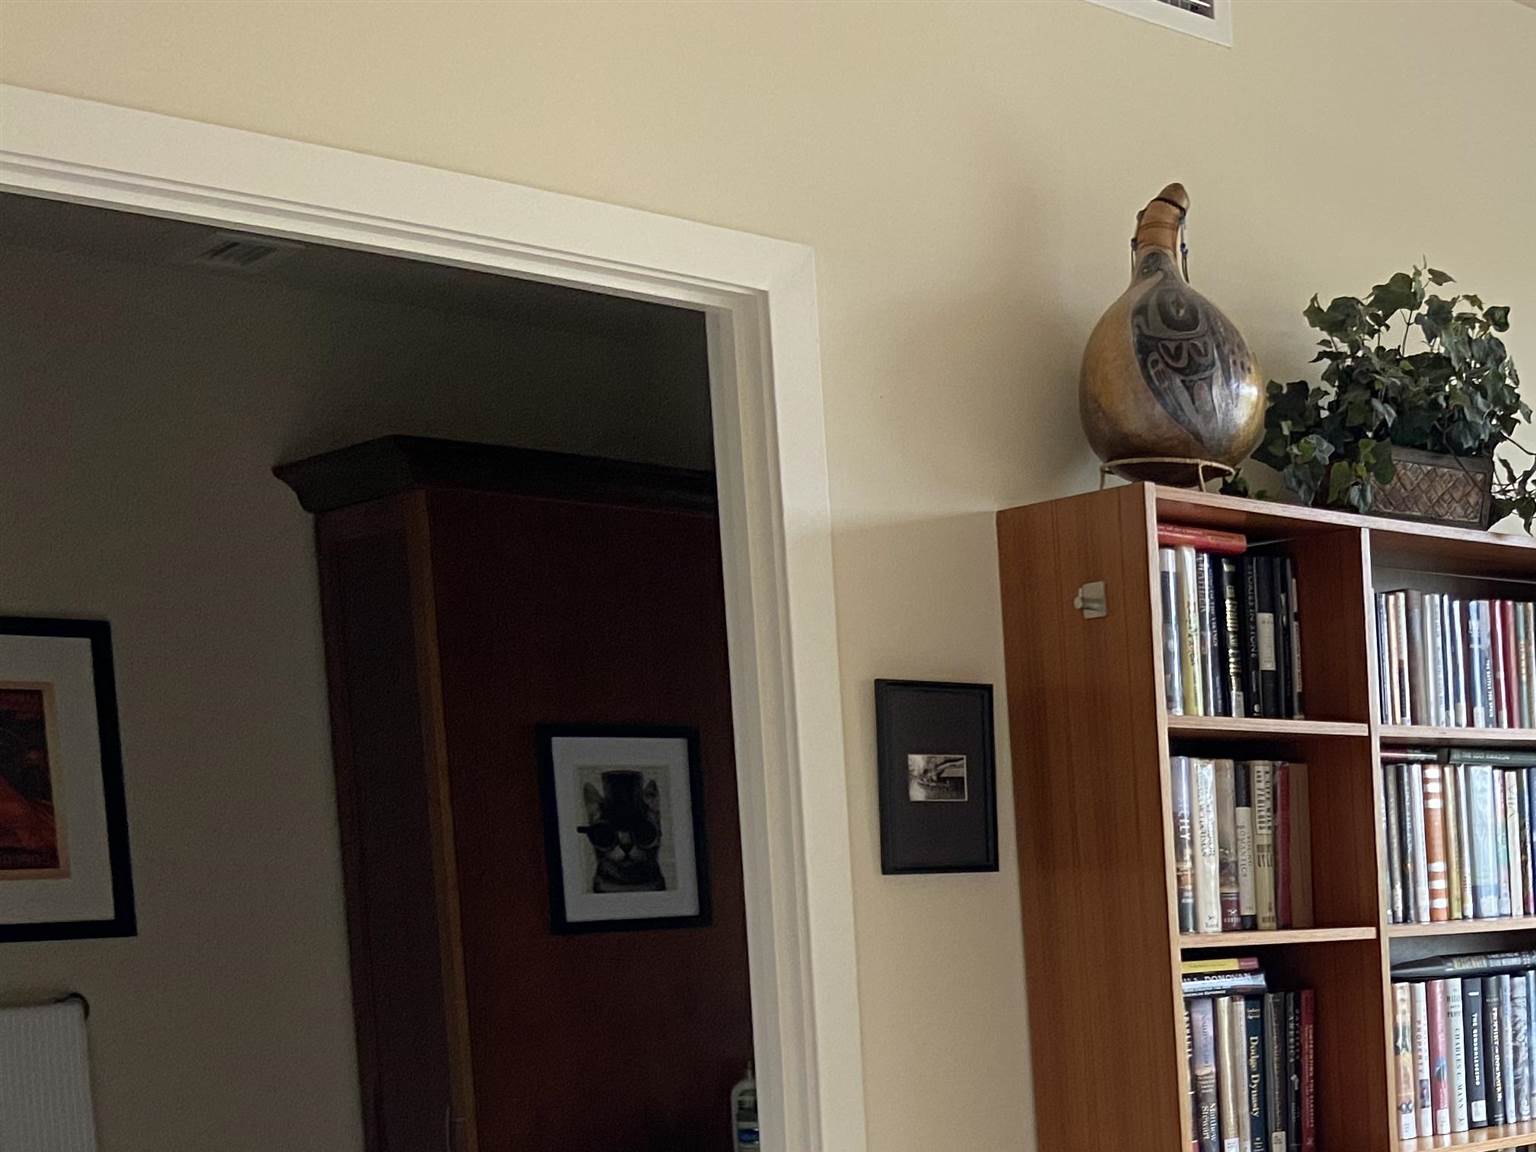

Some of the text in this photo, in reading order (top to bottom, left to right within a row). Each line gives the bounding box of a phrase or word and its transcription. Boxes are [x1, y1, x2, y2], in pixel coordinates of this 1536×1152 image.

[1287, 1014, 1296, 1062] AMERICA
[1453, 1028, 1462, 1070] CHARLES
[1248, 1035, 1264, 1117] Dodge Dynasty
[1201, 1104, 1210, 1139] Stewart
